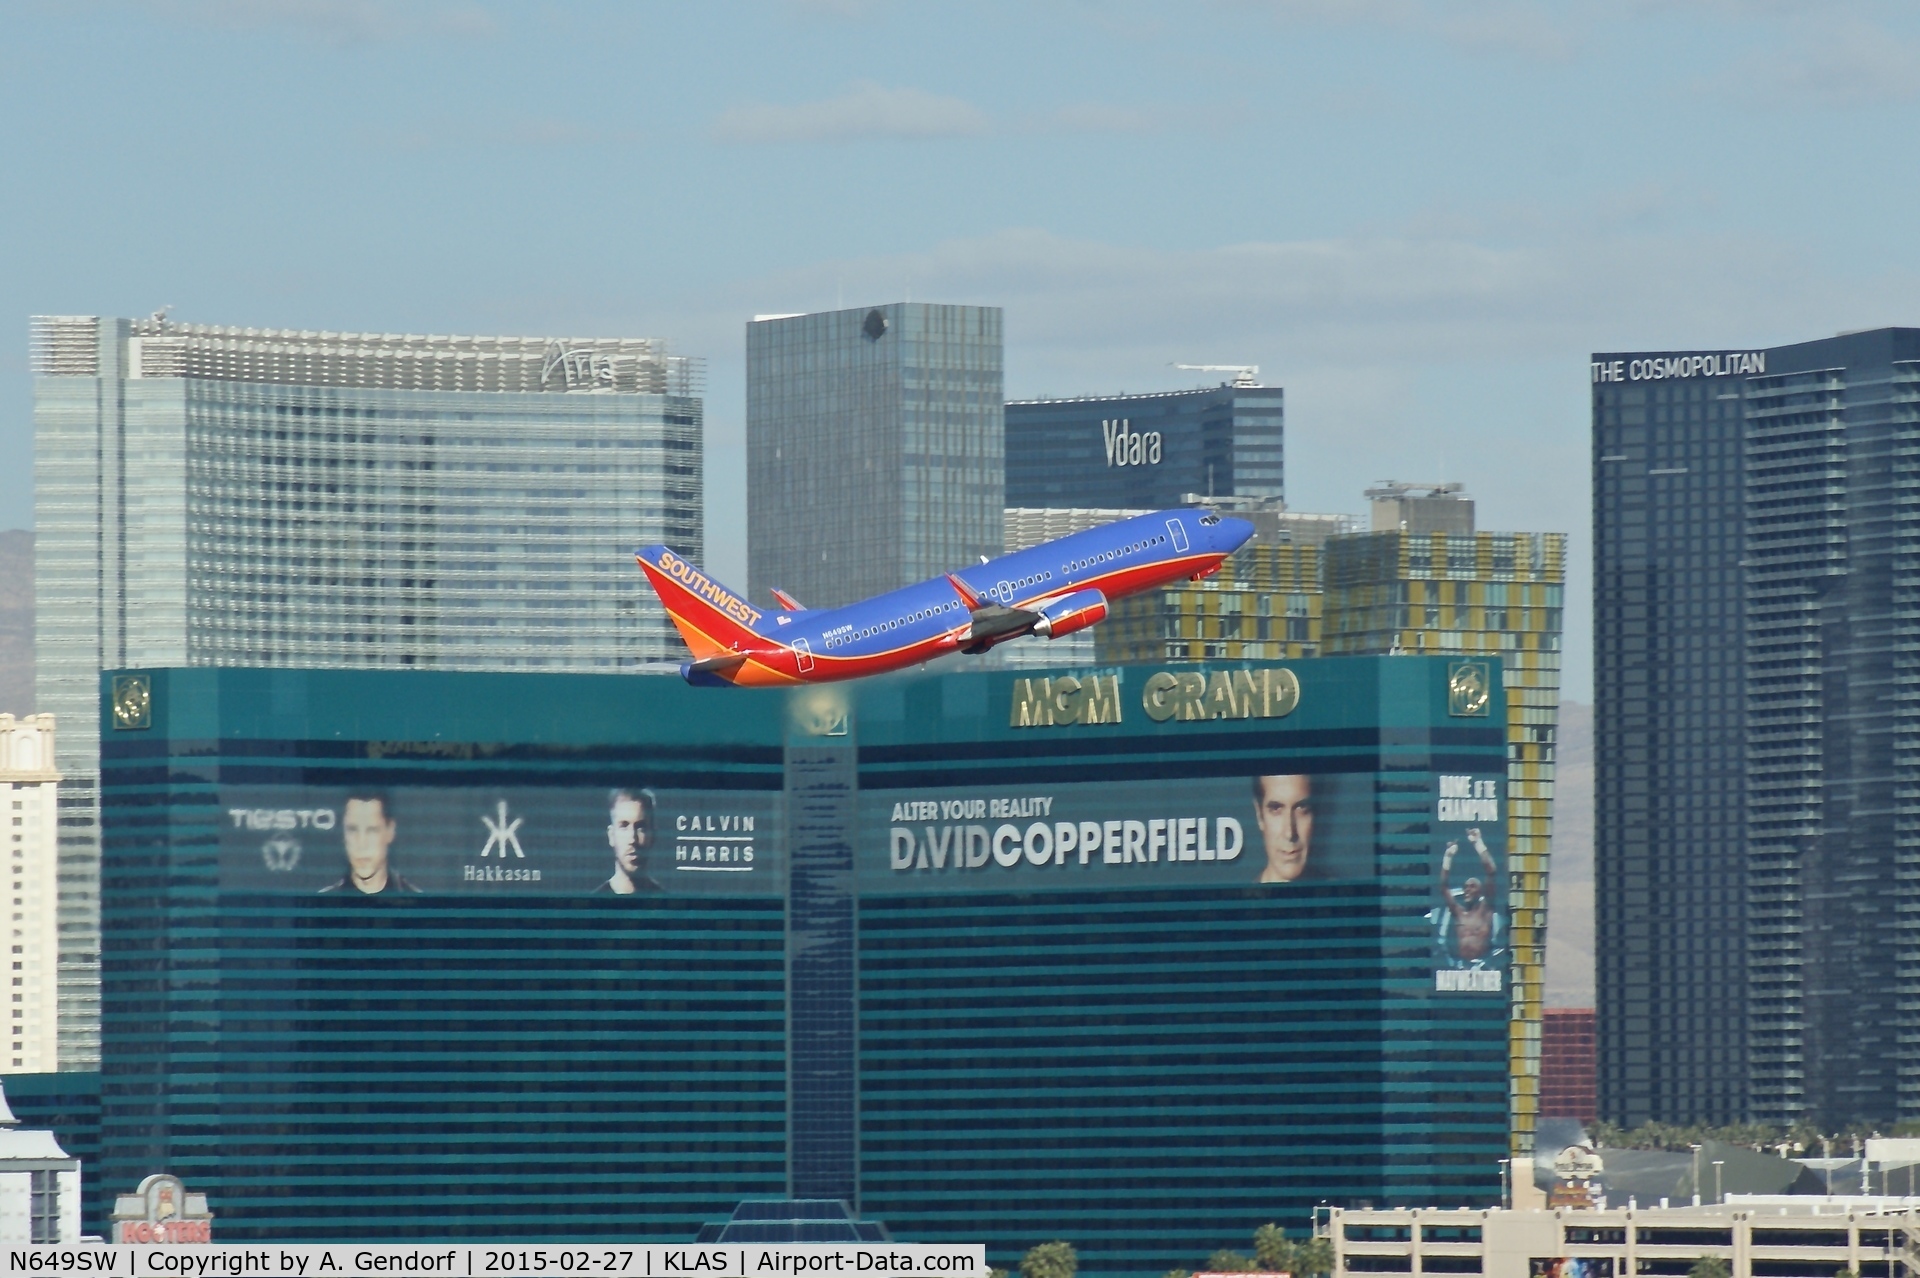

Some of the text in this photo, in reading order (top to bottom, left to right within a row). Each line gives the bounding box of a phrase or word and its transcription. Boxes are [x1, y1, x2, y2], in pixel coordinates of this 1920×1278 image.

[541, 339, 614, 384] Aria
[1591, 352, 1766, 383] THE COSMOPOLITAN
[1102, 418, 1162, 468] Vdara
[658, 552, 762, 627] SOUTHWEST
[822, 624, 853, 640] N649SW
[1009, 668, 1300, 727] MGM GRAND
[676, 815, 754, 831] CALVIN
[891, 797, 1053, 822] ALTER YOUR REALITY
[676, 846, 754, 862] HARRIS
[992, 817, 1244, 867] COPPERFIELD
[464, 865, 541, 881] Hakkasan
[122, 1221, 211, 1244] HOOTERS
